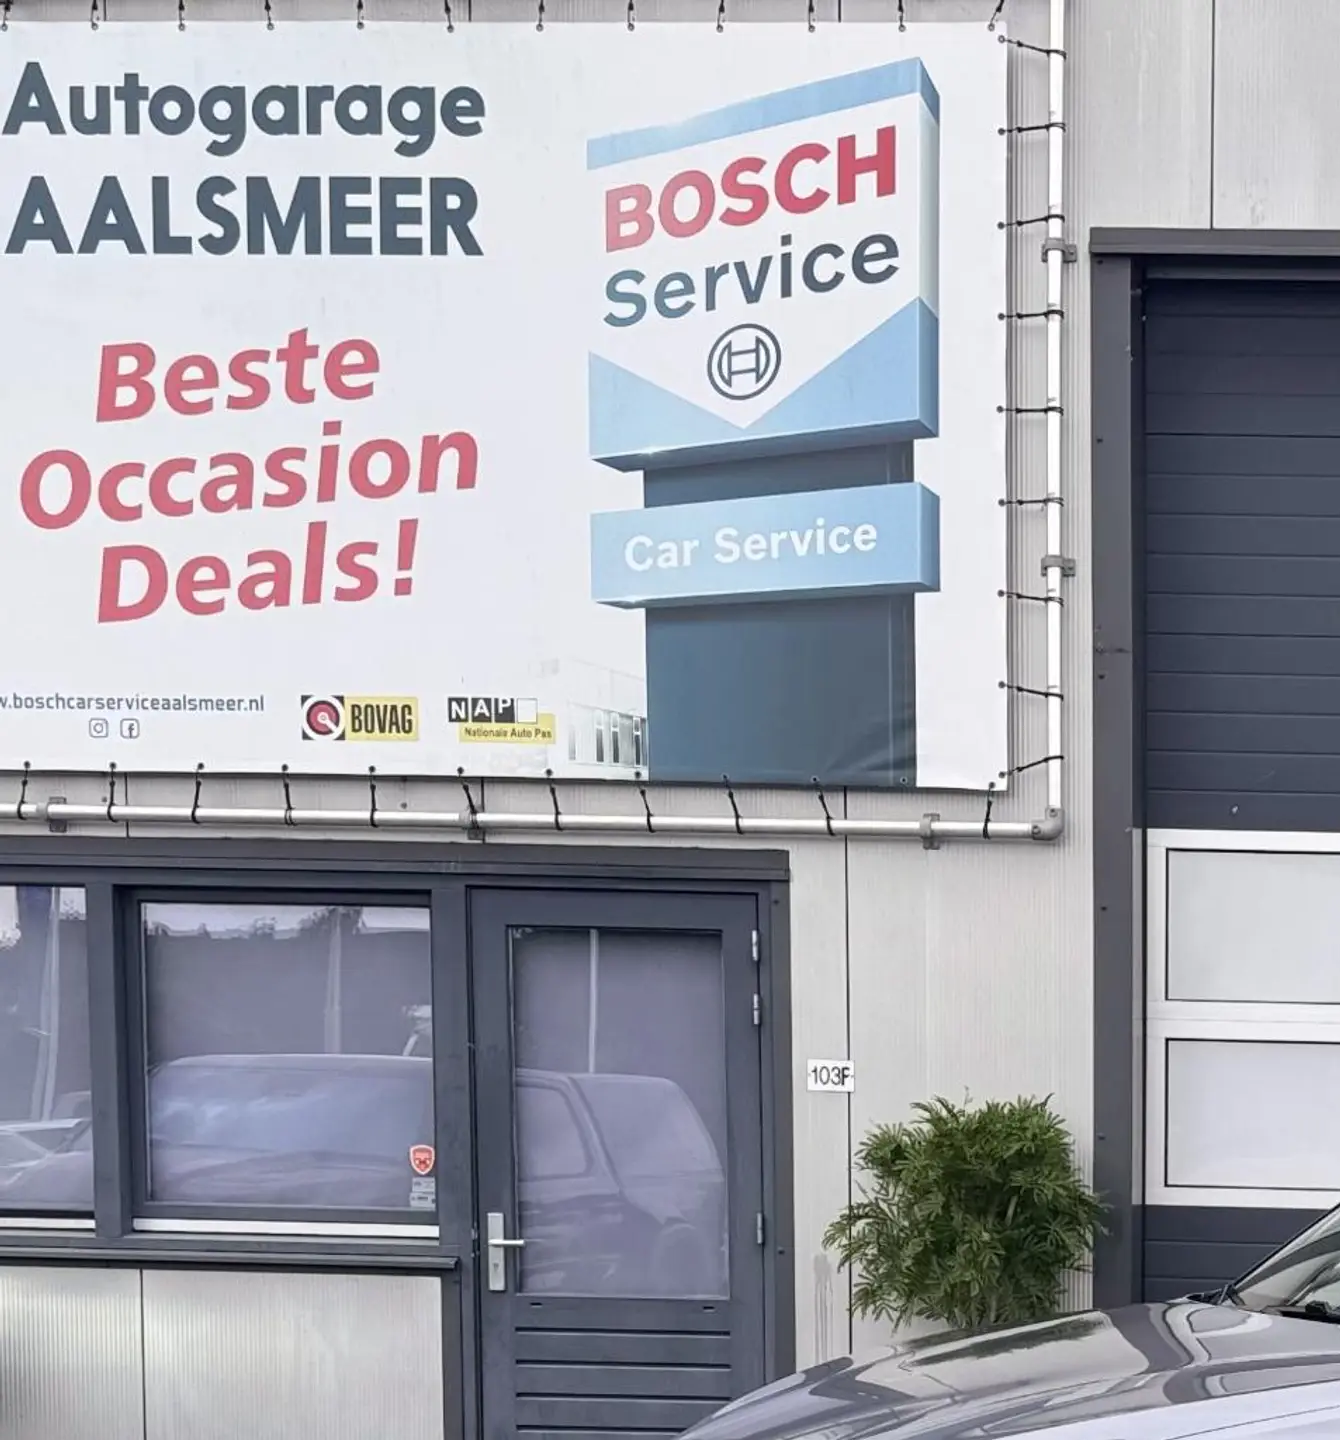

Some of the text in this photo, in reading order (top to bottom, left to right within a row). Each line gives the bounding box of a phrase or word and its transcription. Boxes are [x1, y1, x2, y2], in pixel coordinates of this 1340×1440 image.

[2, 62, 486, 157] Autogarage
[4, 175, 485, 257] AALSMEER
[604, 124, 897, 254] BOSCH
[603, 232, 900, 328] Service
[96, 328, 380, 423] Beste
[19, 421, 479, 530] Occasion
[97, 518, 419, 624] Deals!
[624, 518, 879, 572] Car Service
[350, 703, 413, 734] BOVAG
[451, 697, 512, 720] NAP
[464, 727, 553, 738] Nationale Auto Pas
[811, 1066, 850, 1086] 103F
